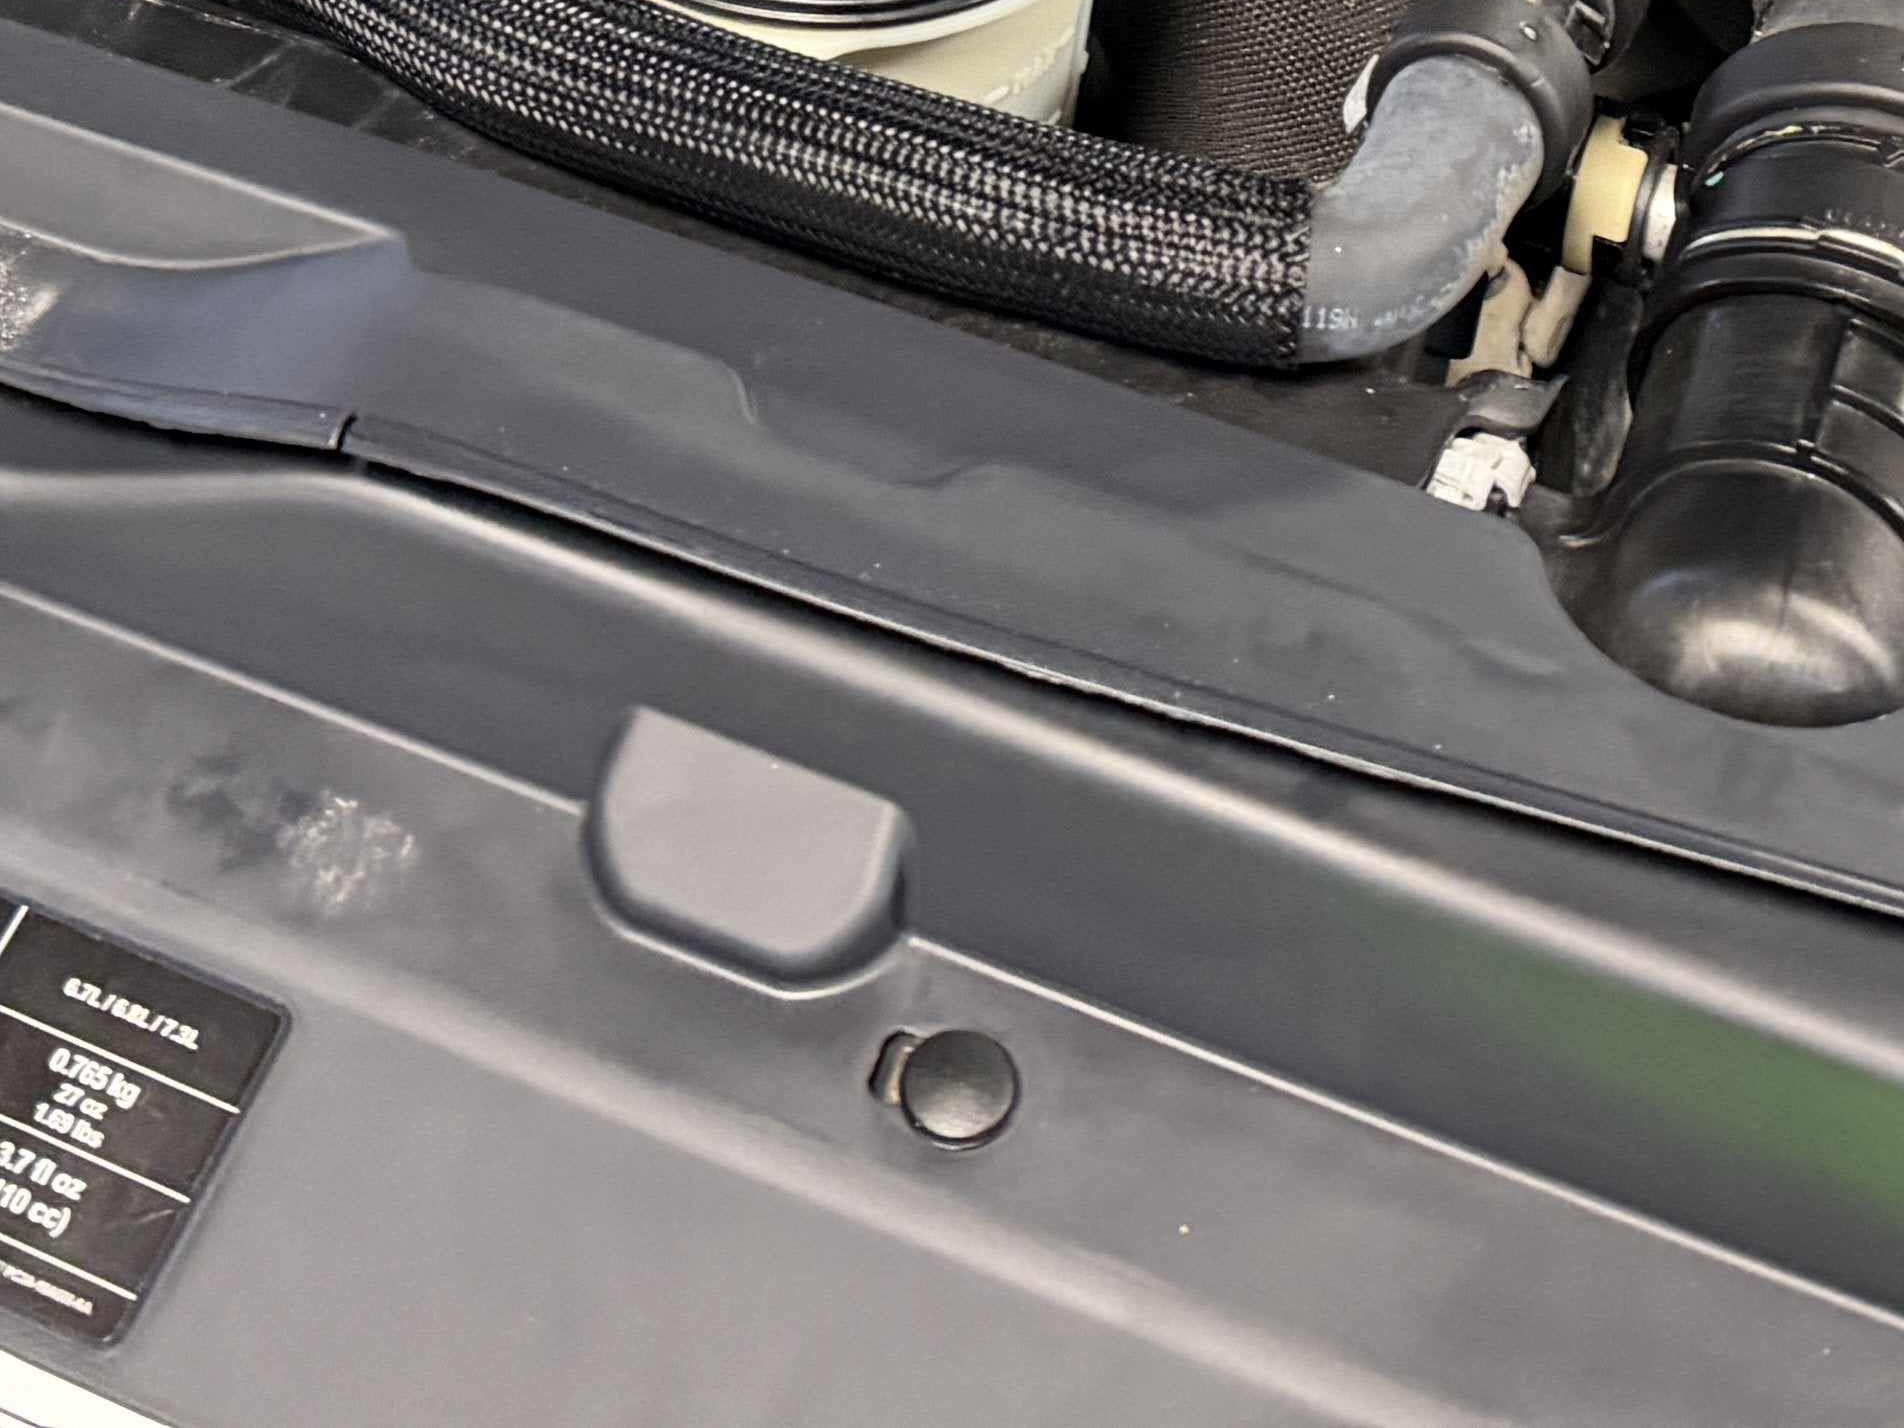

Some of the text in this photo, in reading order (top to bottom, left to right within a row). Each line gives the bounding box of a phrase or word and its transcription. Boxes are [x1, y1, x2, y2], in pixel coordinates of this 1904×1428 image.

[49, 1048, 141, 1109] 0.765 kg
[53, 1083, 108, 1120] 27 oz
[70, 1120, 105, 1148] lbs
[30, 1158, 57, 1186] fl
[51, 1172, 87, 1201] oz
[27, 1201, 71, 1238] cc)
